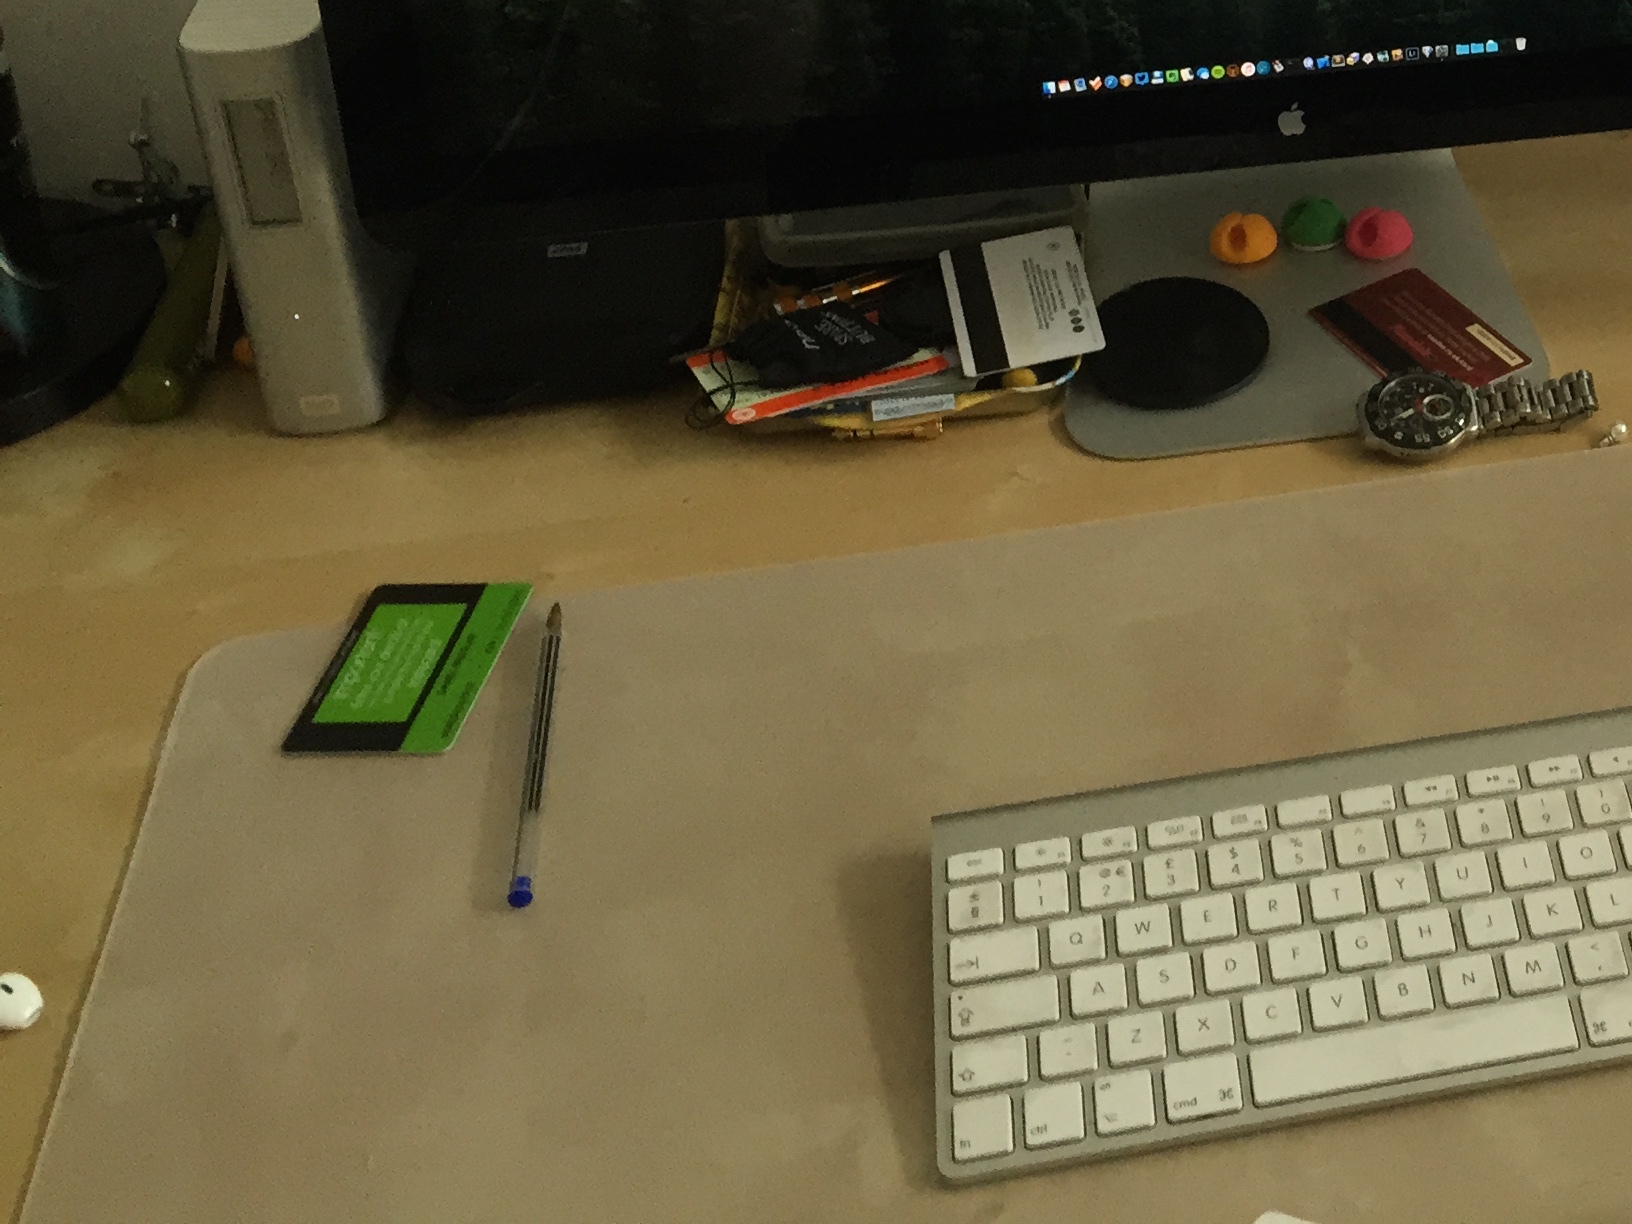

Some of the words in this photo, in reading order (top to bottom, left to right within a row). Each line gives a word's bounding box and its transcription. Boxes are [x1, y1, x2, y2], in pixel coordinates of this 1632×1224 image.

[1579, 846, 1594, 860] O
[1456, 866, 1469, 880] U
[1395, 877, 1405, 890] Y
[1332, 887, 1340, 901] T
[1609, 893, 1618, 907] L
[1268, 899, 1278, 912] R
[1546, 903, 1559, 917] K
[1202, 909, 1211, 923] E
[1134, 920, 1151, 935] W
[1418, 924, 1432, 939] H
[1069, 932, 1084, 945] Q
[1354, 938, 1369, 950] G
[1224, 958, 1237, 972] D
[1525, 959, 1542, 974] M
[1158, 969, 1170, 984] S
[1461, 971, 1476, 986] N
[1092, 981, 1105, 996] A
[1397, 982, 1409, 997] B
[1330, 994, 1343, 1009] V
[1265, 1005, 1277, 1019] C
[1197, 1018, 1211, 1032] X
[1131, 1027, 1141, 1044] Z
[1172, 1098, 1198, 1110] cmd
